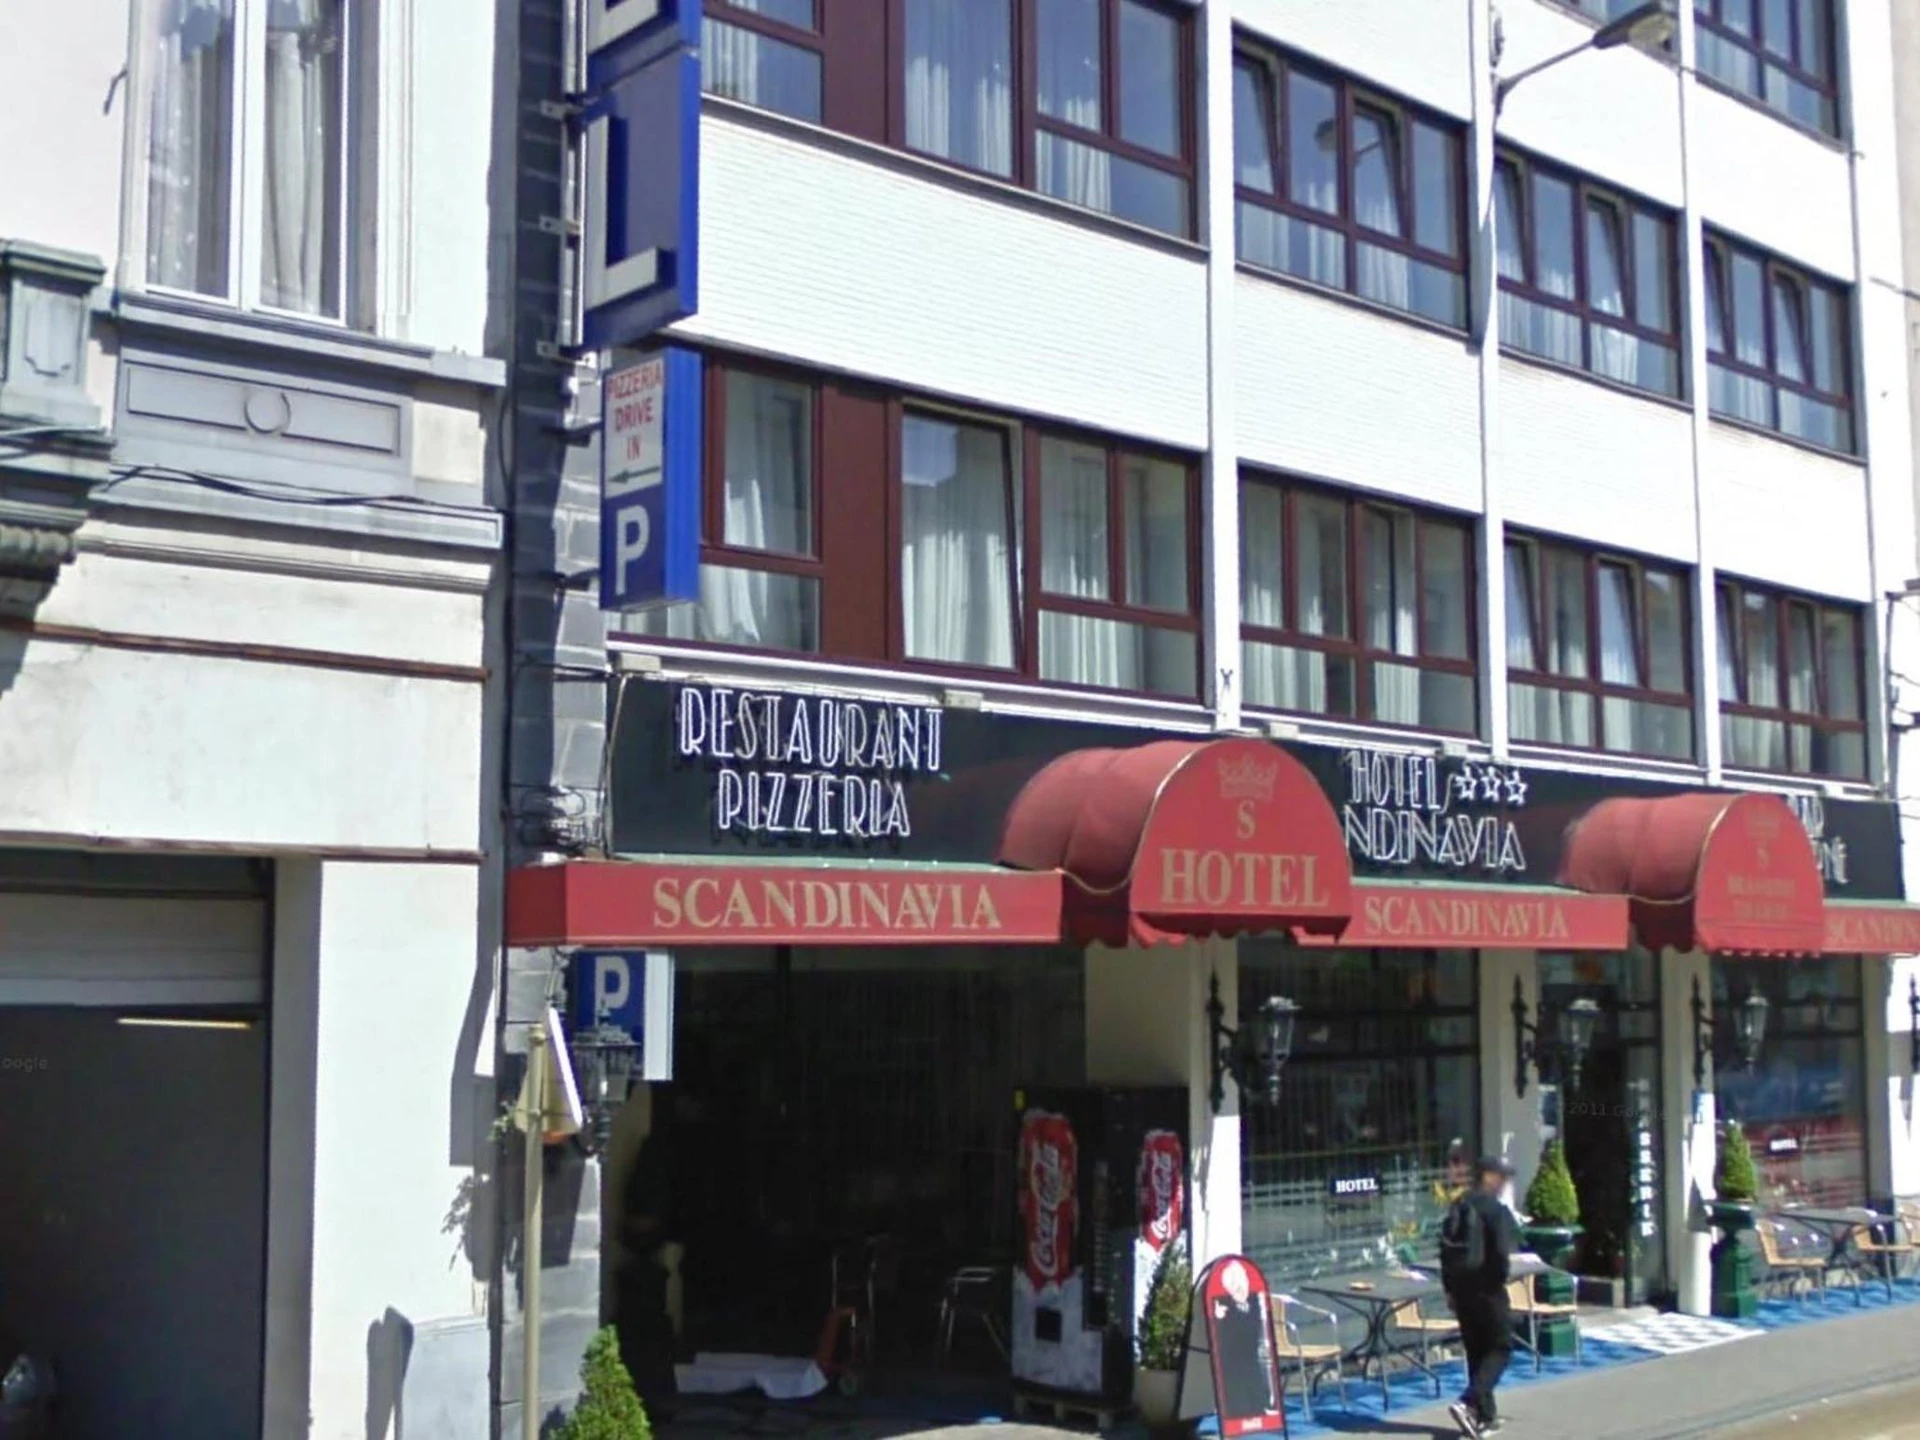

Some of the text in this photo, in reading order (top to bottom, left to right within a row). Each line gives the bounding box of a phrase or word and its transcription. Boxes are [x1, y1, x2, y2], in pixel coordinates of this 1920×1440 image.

[605, 361, 663, 399] PIZZERIA
[614, 397, 654, 432] DRIVE
[627, 436, 641, 460] IN
[615, 504, 649, 596] P
[680, 687, 943, 772] RESTAURANT
[717, 770, 911, 837] PIZZERIA
[1350, 749, 1441, 810] HOTEL
[1236, 801, 1256, 840] S
[653, 877, 1002, 930] SCANDINAVIA
[1160, 848, 1330, 908] HOTEL
[1365, 896, 1569, 939] SCANDINAVIA
[594, 955, 630, 1029] P
[1335, 1177, 1379, 1194] HOTEL
